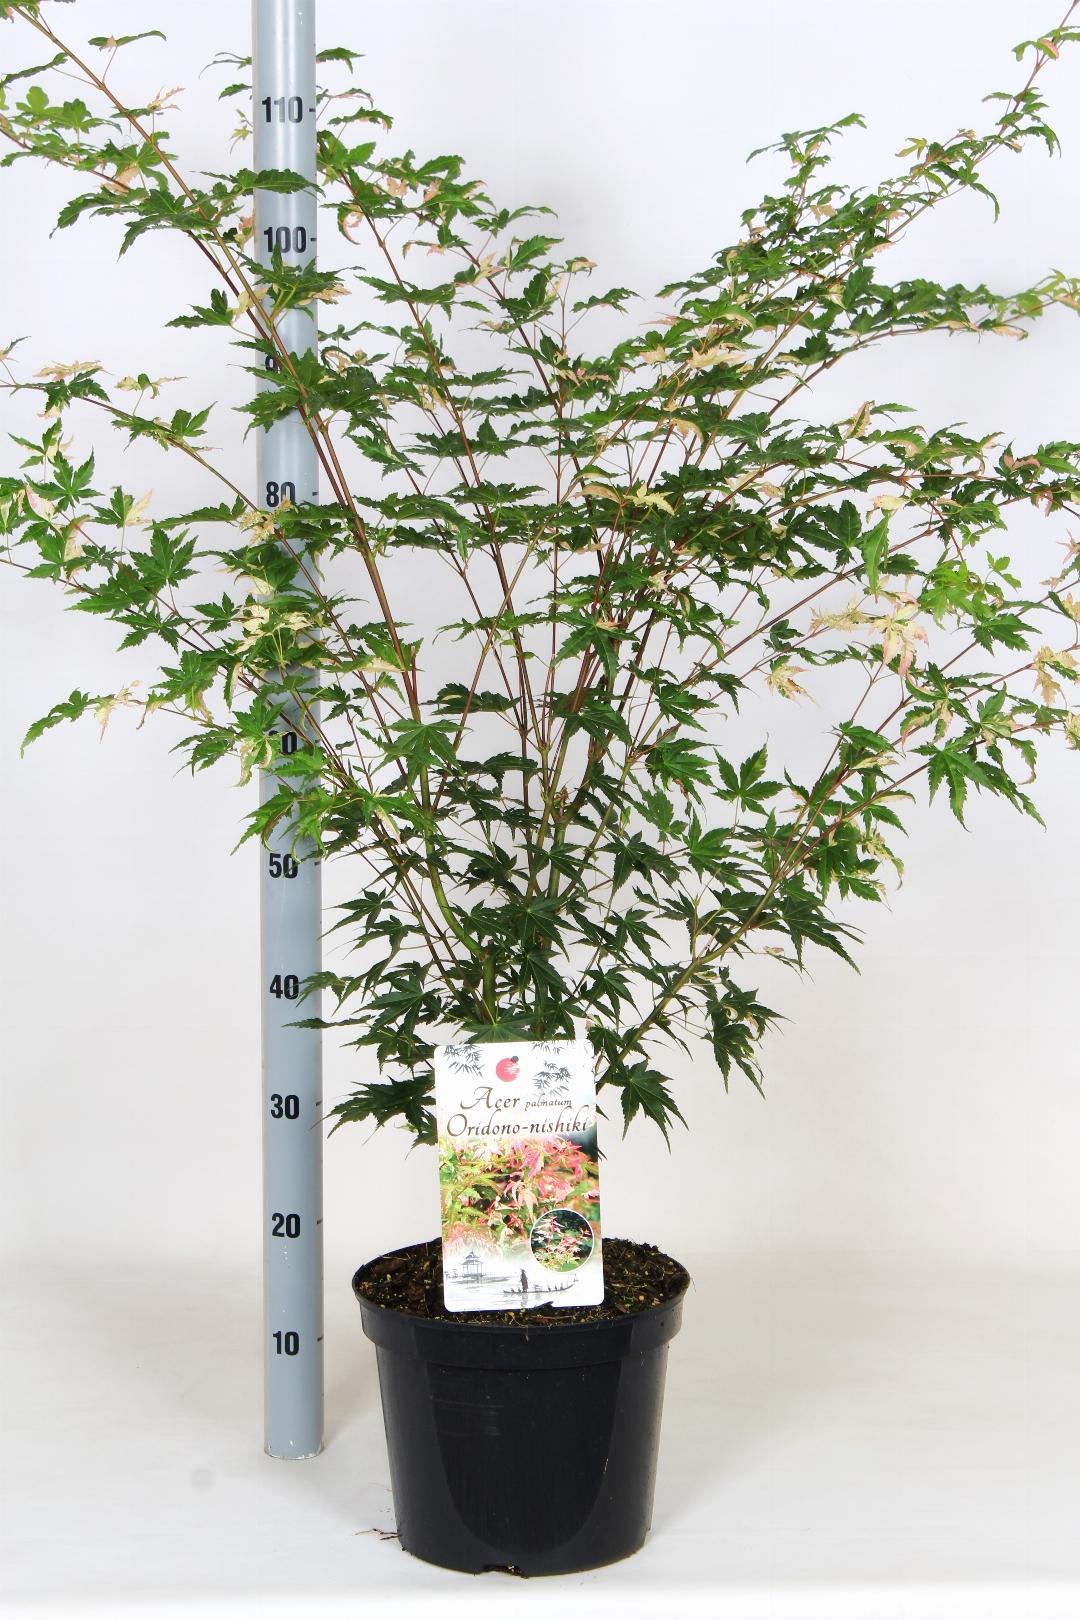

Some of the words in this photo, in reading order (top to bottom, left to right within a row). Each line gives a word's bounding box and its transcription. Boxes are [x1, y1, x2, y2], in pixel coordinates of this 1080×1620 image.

[262, 96, 304, 123] 110
[264, 226, 307, 254] 100
[266, 481, 296, 508] 80
[268, 730, 298, 755] 0
[269, 852, 299, 879] 50
[269, 974, 299, 1000] 40
[270, 1093, 300, 1120] 30
[460, 1086, 520, 1110] Acer
[524, 1093, 572, 1111] palmatum
[446, 1104, 589, 1137] Oridono-nishiki
[271, 1212, 301, 1239] 20
[272, 1330, 300, 1356] 10
